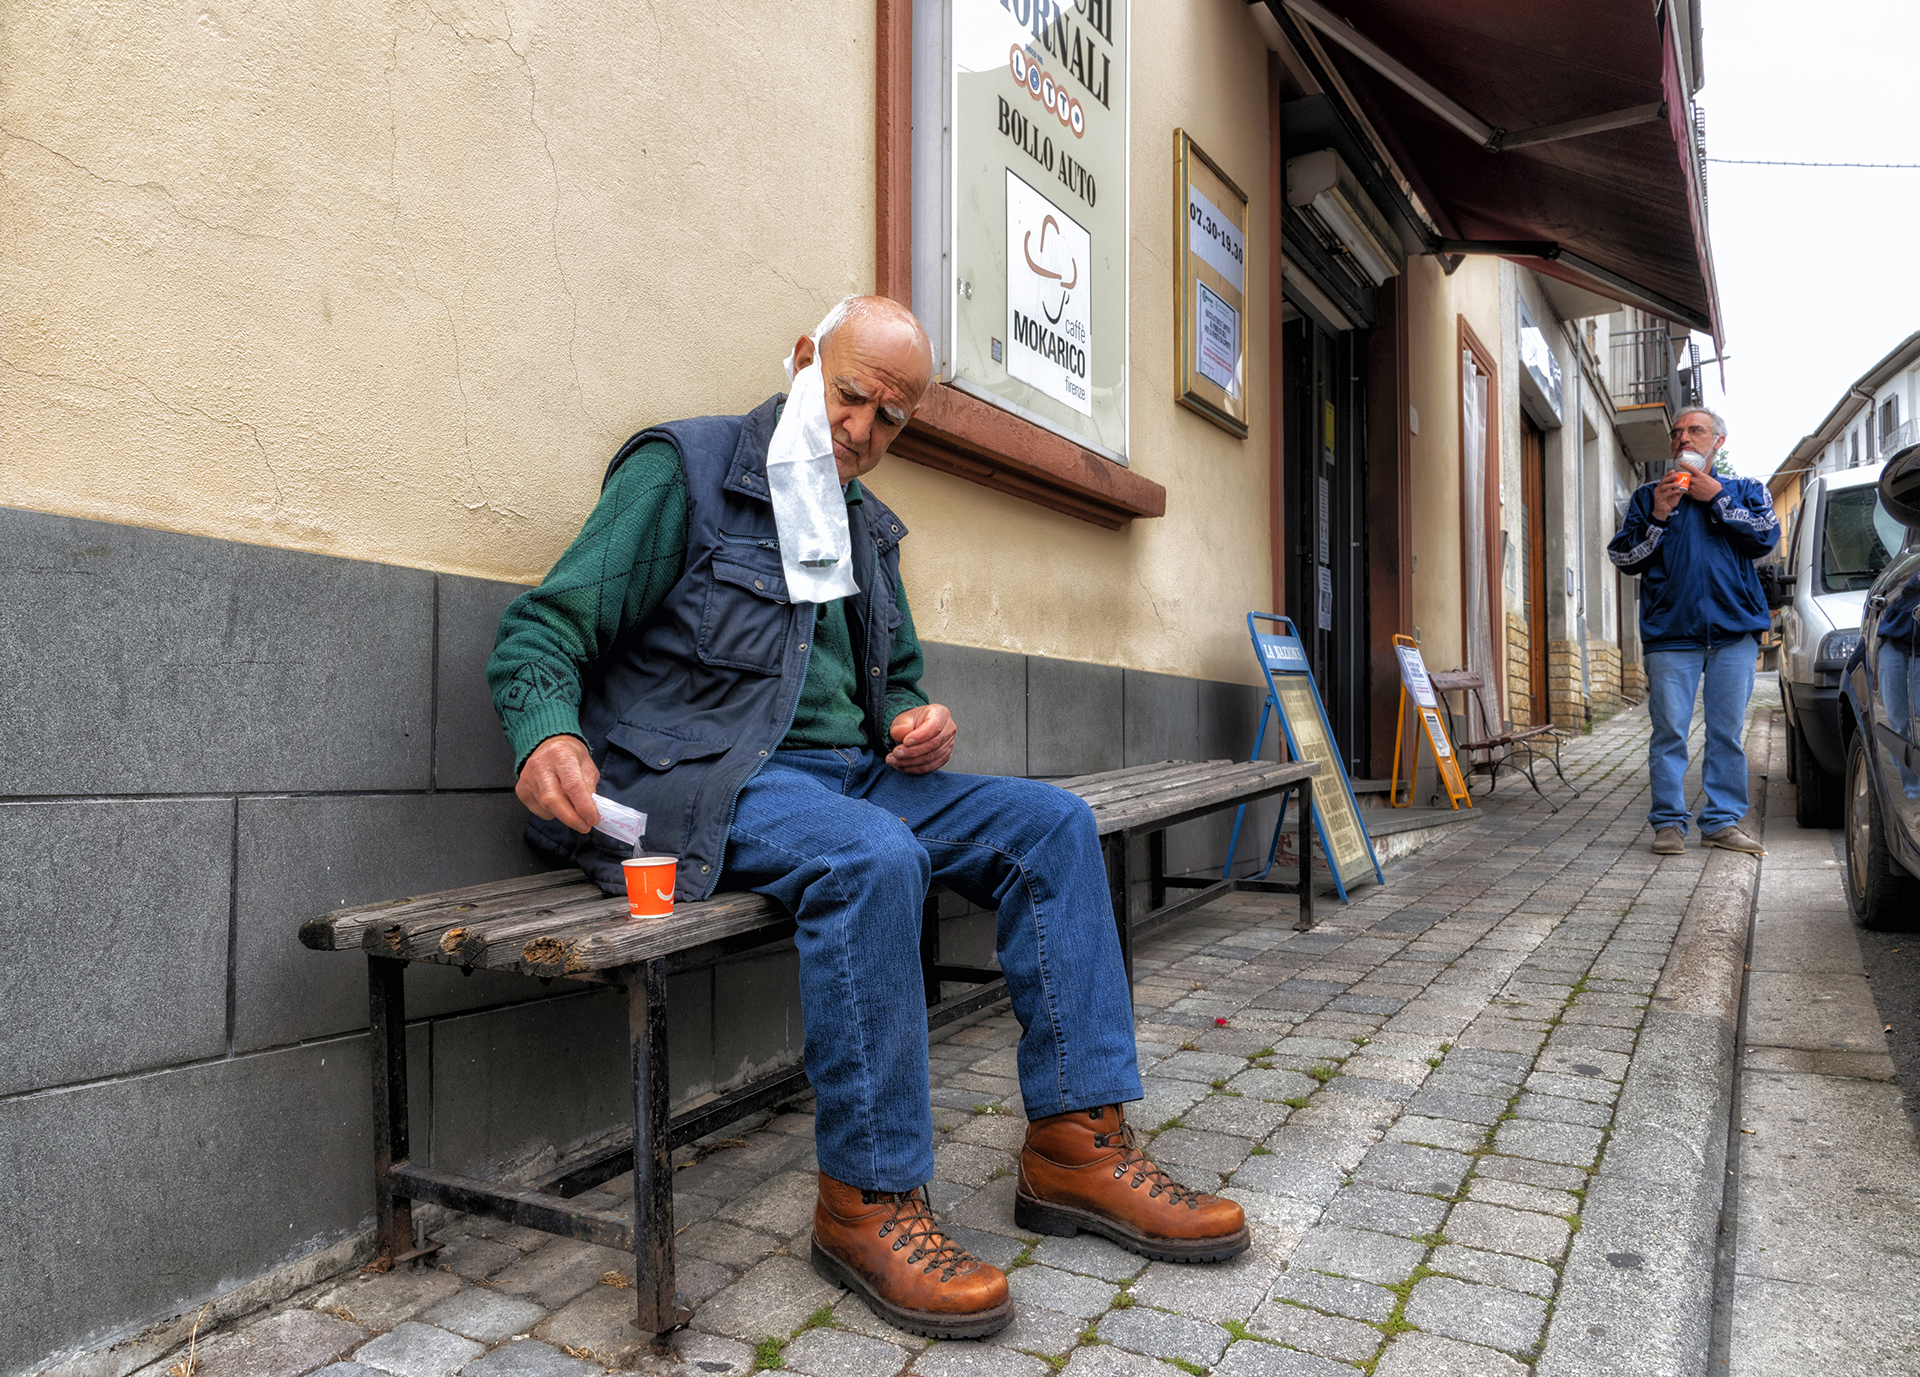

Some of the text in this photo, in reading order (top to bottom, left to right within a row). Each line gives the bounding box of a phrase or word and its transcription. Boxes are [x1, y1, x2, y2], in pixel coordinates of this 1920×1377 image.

[1013, 50, 1082, 132] LOTTO
[998, 94, 1096, 208] BOLLO AUTO
[1190, 202, 1243, 265] 07.30-19.30
[1014, 309, 1086, 379] MOKARICO
[1065, 319, 1086, 344] caffè
[1065, 376, 1086, 401] firenze
[1263, 644, 1303, 660] LA NAZIONE
[1328, 810, 1352, 834] REGOLE
